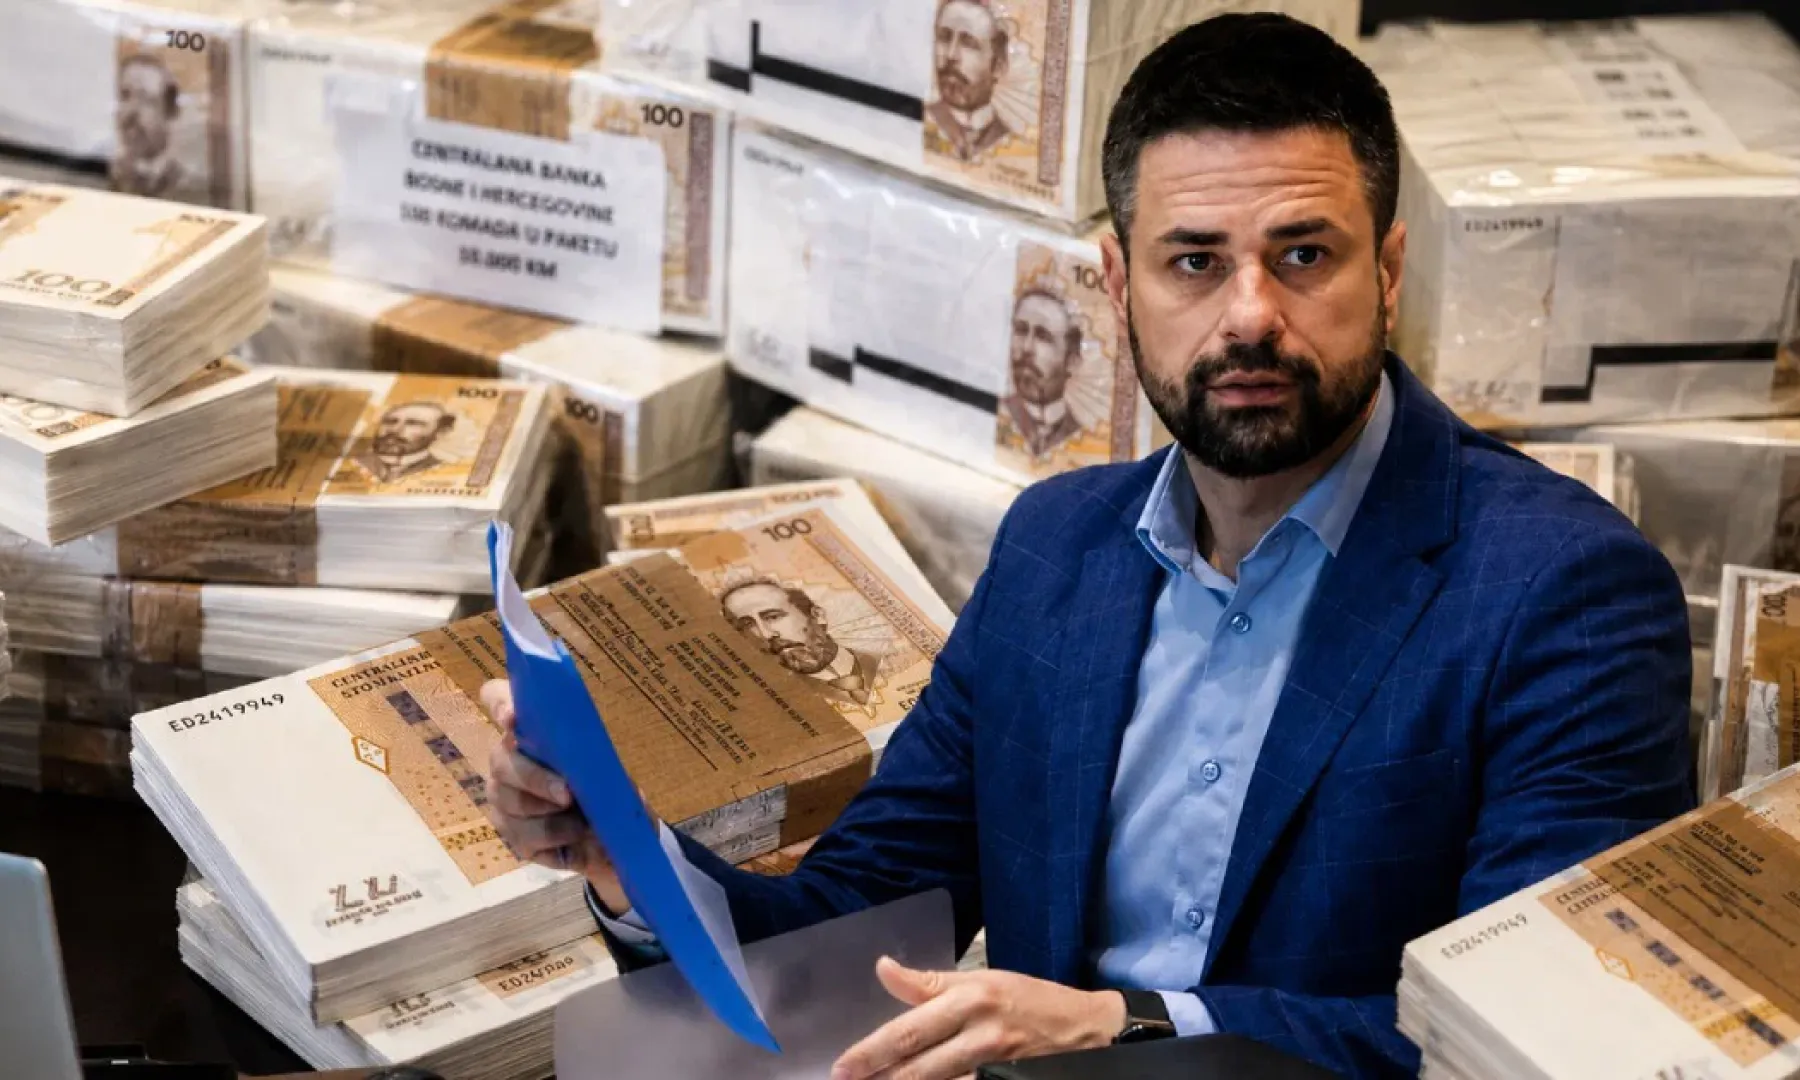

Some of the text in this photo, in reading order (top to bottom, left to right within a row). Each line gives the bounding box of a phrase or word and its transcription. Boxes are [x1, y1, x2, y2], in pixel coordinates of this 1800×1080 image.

[165, 30, 206, 53] 100
[641, 102, 684, 128] 100
[404, 169, 463, 197] BOSNE
[540, 160, 606, 188] BANKA
[523, 225, 541, 245] U
[526, 259, 558, 278] KM
[14, 269, 112, 294] 100
[761, 517, 812, 542] 100
[168, 692, 285, 733] ED2419949
[1440, 911, 1528, 960] ED2419949
